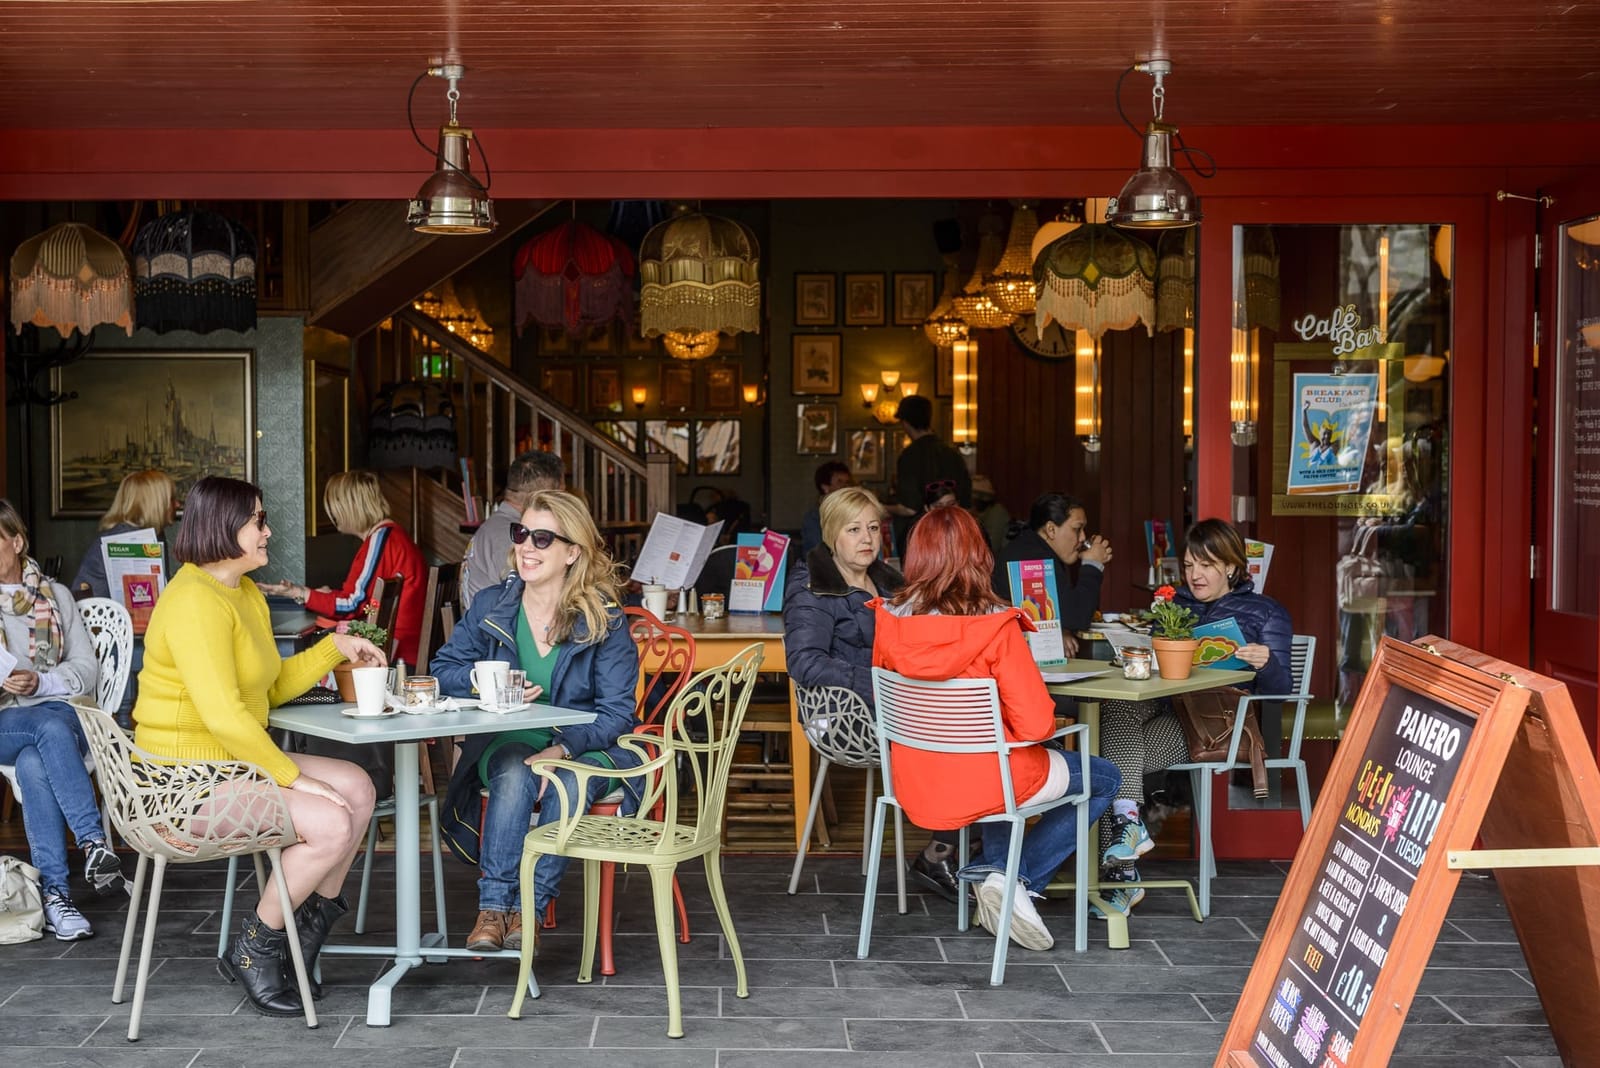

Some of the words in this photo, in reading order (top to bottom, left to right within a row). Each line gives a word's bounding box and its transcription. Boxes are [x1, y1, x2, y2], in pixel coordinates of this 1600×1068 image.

[1294, 304, 1360, 342] Café
[1333, 325, 1386, 355] Bar
[1306, 389, 1366, 397] BREAKFAST
[1396, 705, 1460, 761] PANERO
[1395, 747, 1437, 784] LOUNGE
[1357, 760, 1396, 816] CHEEKY
[1345, 802, 1381, 838] MONDAYS
[1333, 890, 1350, 914] GLASS
[1368, 873, 1378, 893] 3
[1374, 876, 1395, 907] TAPAS
[1377, 914, 1387, 937] &
[1335, 964, 1374, 1017] £10.5
